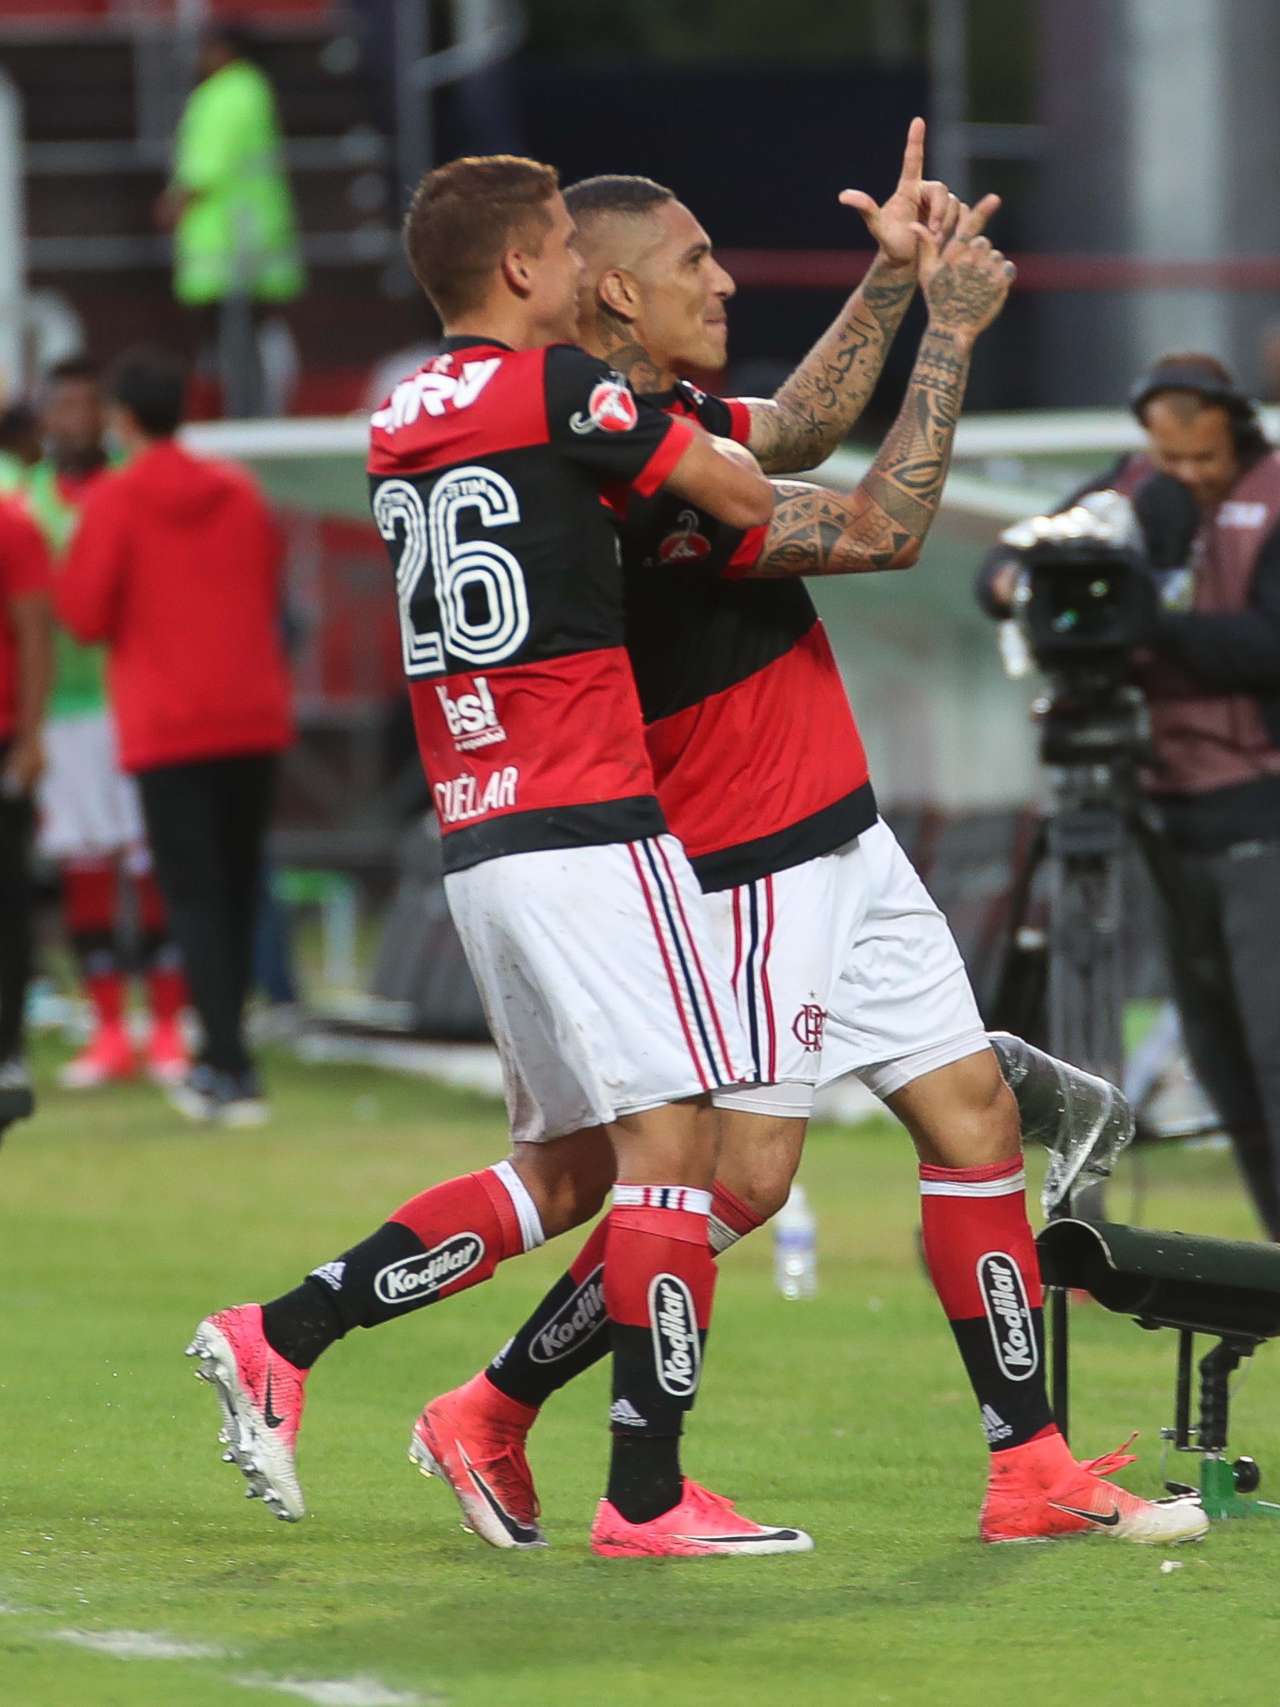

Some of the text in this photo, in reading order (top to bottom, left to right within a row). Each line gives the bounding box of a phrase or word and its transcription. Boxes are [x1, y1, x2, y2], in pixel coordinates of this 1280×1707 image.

[373, 465, 531, 676] 26
[386, 1242, 476, 1298] Kodilar
[987, 1260, 1033, 1367] Kodilar
[659, 1282, 694, 1386] Kodilar
